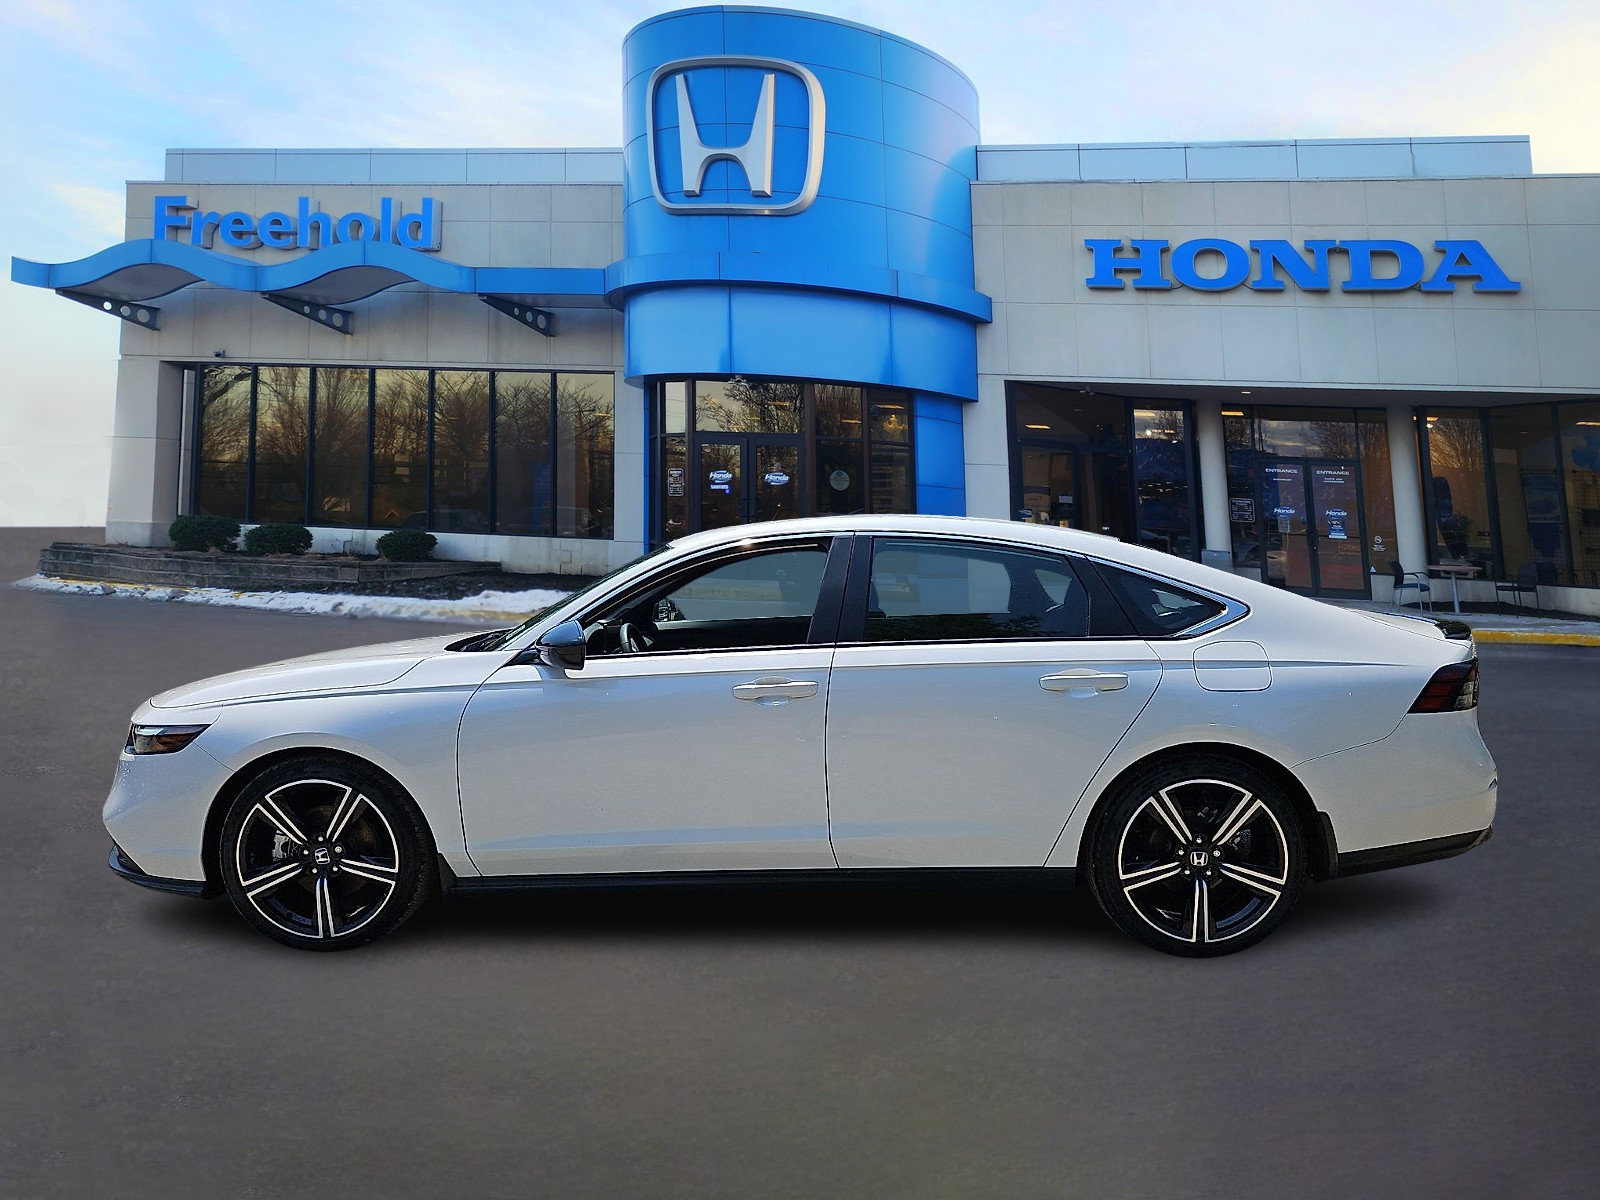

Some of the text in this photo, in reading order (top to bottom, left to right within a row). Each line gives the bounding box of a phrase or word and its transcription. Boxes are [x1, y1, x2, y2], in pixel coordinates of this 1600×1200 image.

[154, 195, 442, 251] Freehold
[1084, 238, 1521, 292] HONDA
[708, 471, 733, 480] Honda
[764, 473, 789, 482] Honda
